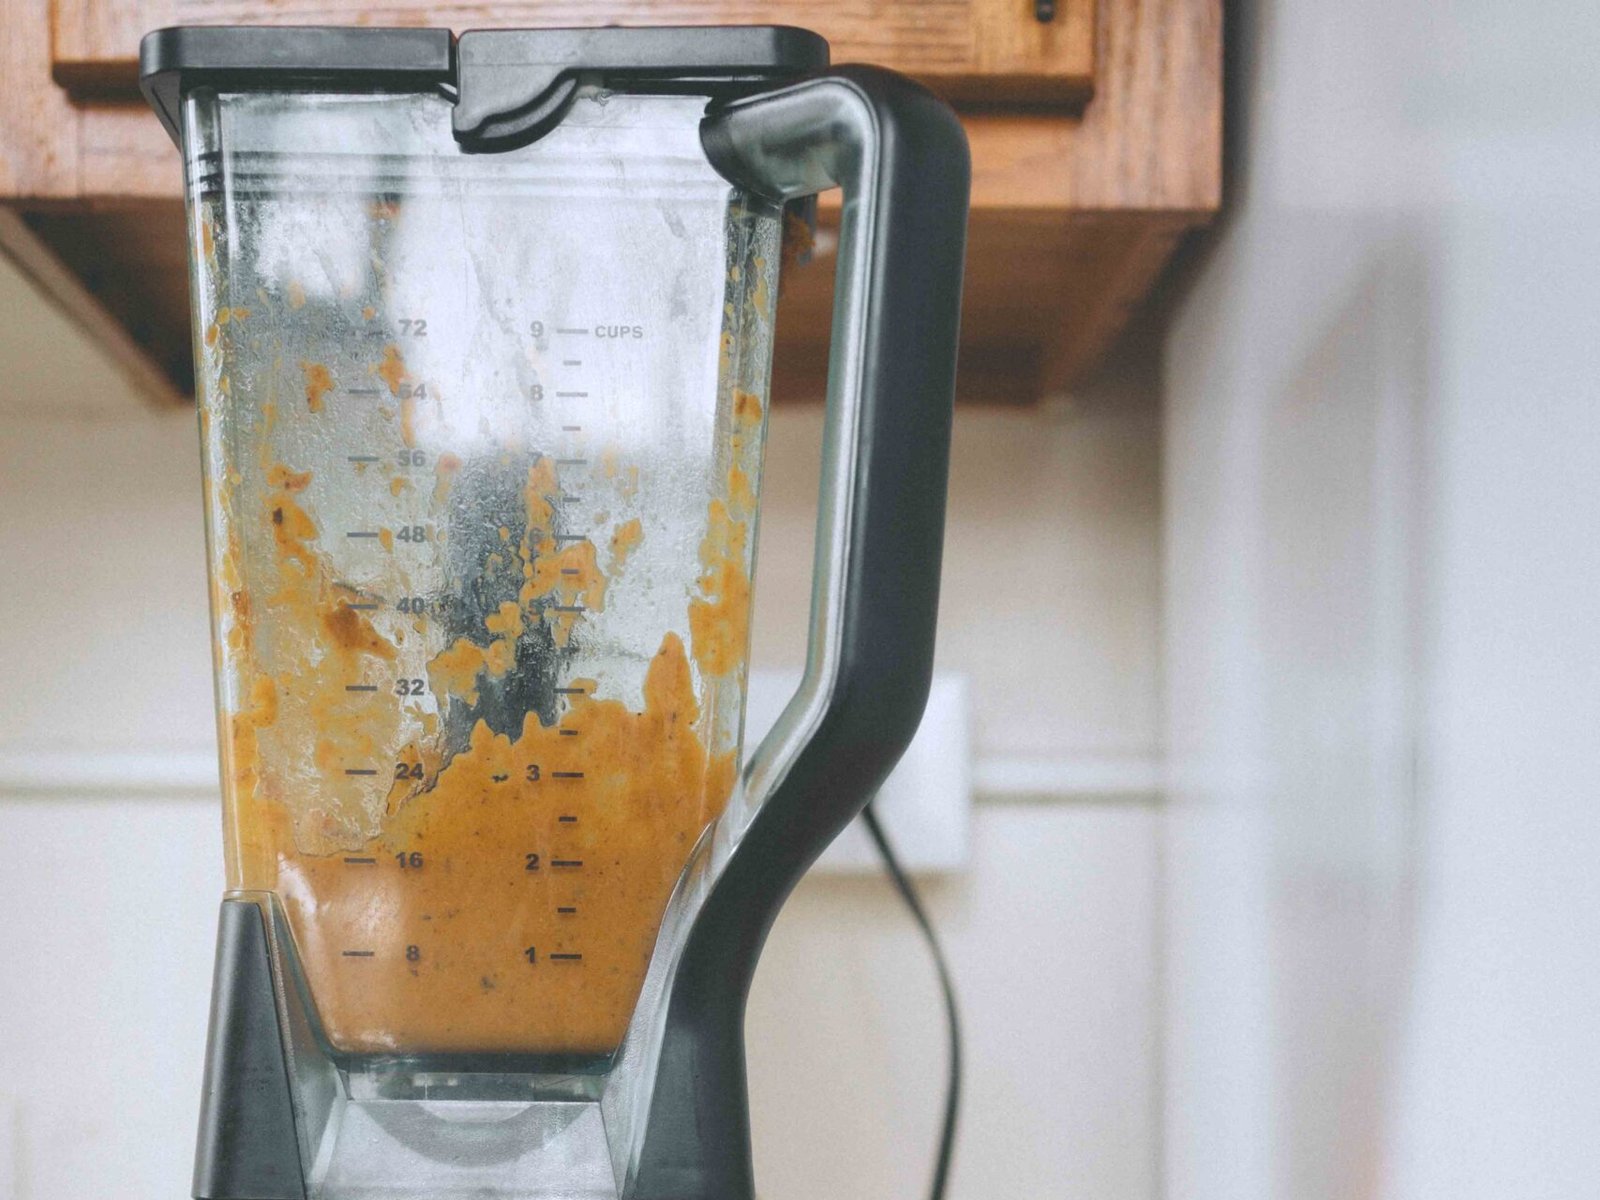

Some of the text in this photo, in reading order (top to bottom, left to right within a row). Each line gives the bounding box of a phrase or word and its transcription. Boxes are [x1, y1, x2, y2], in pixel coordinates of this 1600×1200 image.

[399, 319, 427, 337] 72
[530, 321, 644, 338] 9 CUPS
[530, 384, 544, 401] 8
[398, 450, 426, 467] 56
[396, 526, 426, 543] 48
[396, 598, 425, 614] 40
[395, 679, 425, 695] 32
[395, 763, 424, 780] 24
[526, 765, 540, 782] 3
[395, 852, 423, 869] 16
[525, 853, 539, 870] 2
[406, 945, 420, 962] 8
[525, 947, 537, 964] 1
